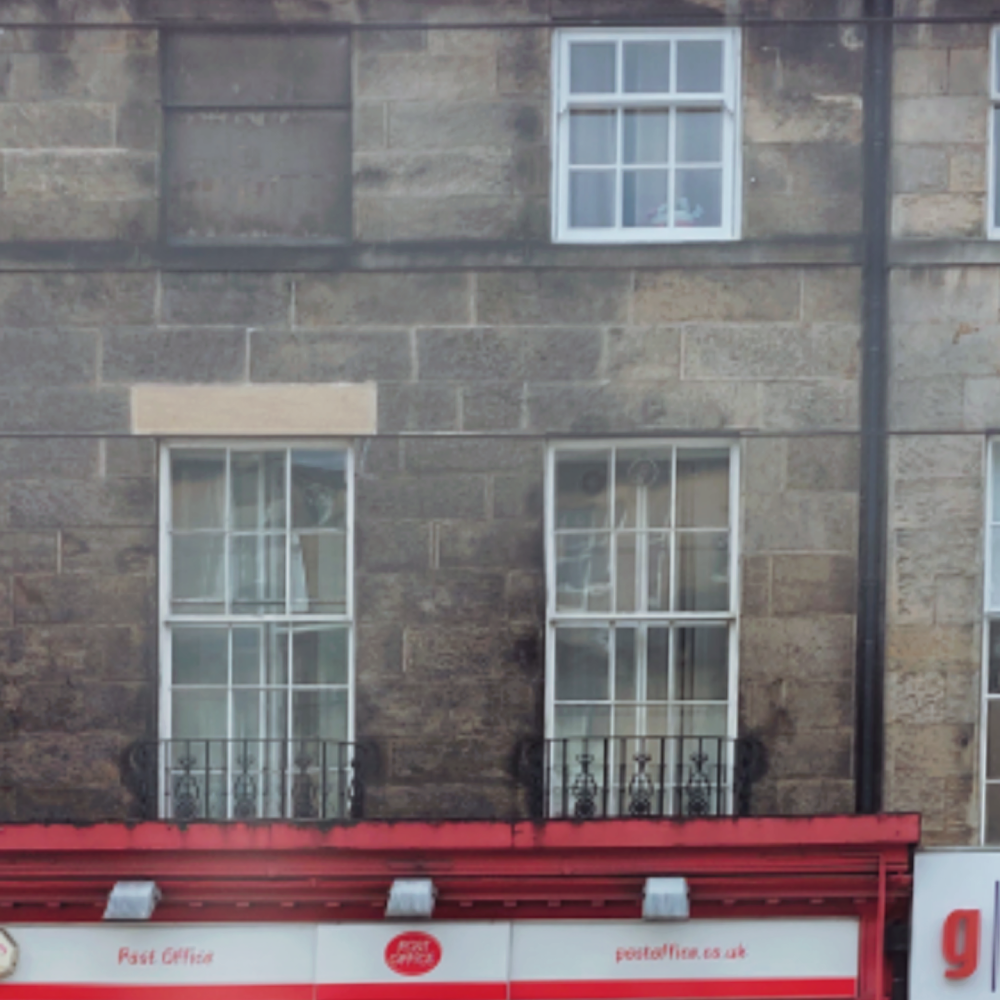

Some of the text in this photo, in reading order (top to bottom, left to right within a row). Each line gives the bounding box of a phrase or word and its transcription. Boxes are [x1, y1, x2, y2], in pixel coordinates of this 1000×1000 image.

[615, 942, 748, 964] postoffice.co.uk
[941, 908, 982, 979] g
[118, 947, 214, 965] Post Office
